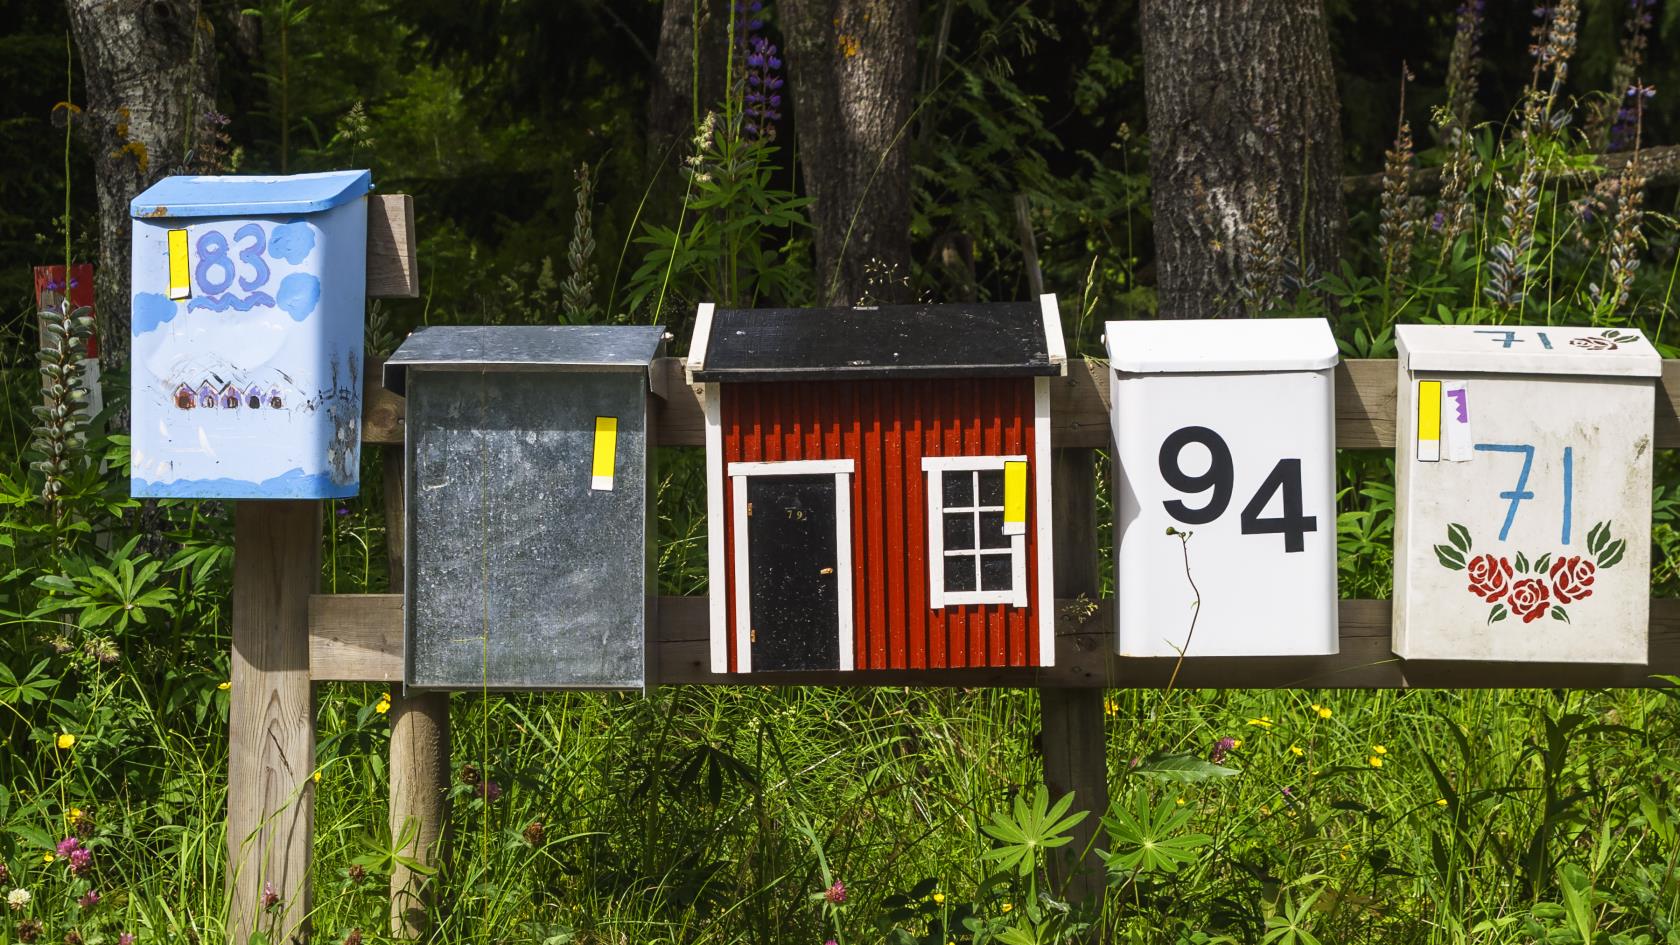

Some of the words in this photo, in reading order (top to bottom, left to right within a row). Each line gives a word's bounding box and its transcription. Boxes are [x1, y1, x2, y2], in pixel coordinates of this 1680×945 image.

[195, 223, 271, 294] 83
[1473, 330, 1554, 350] 71
[786, 509, 804, 520] 79
[1158, 425, 1317, 553] 94
[1474, 443, 1573, 545] 71
